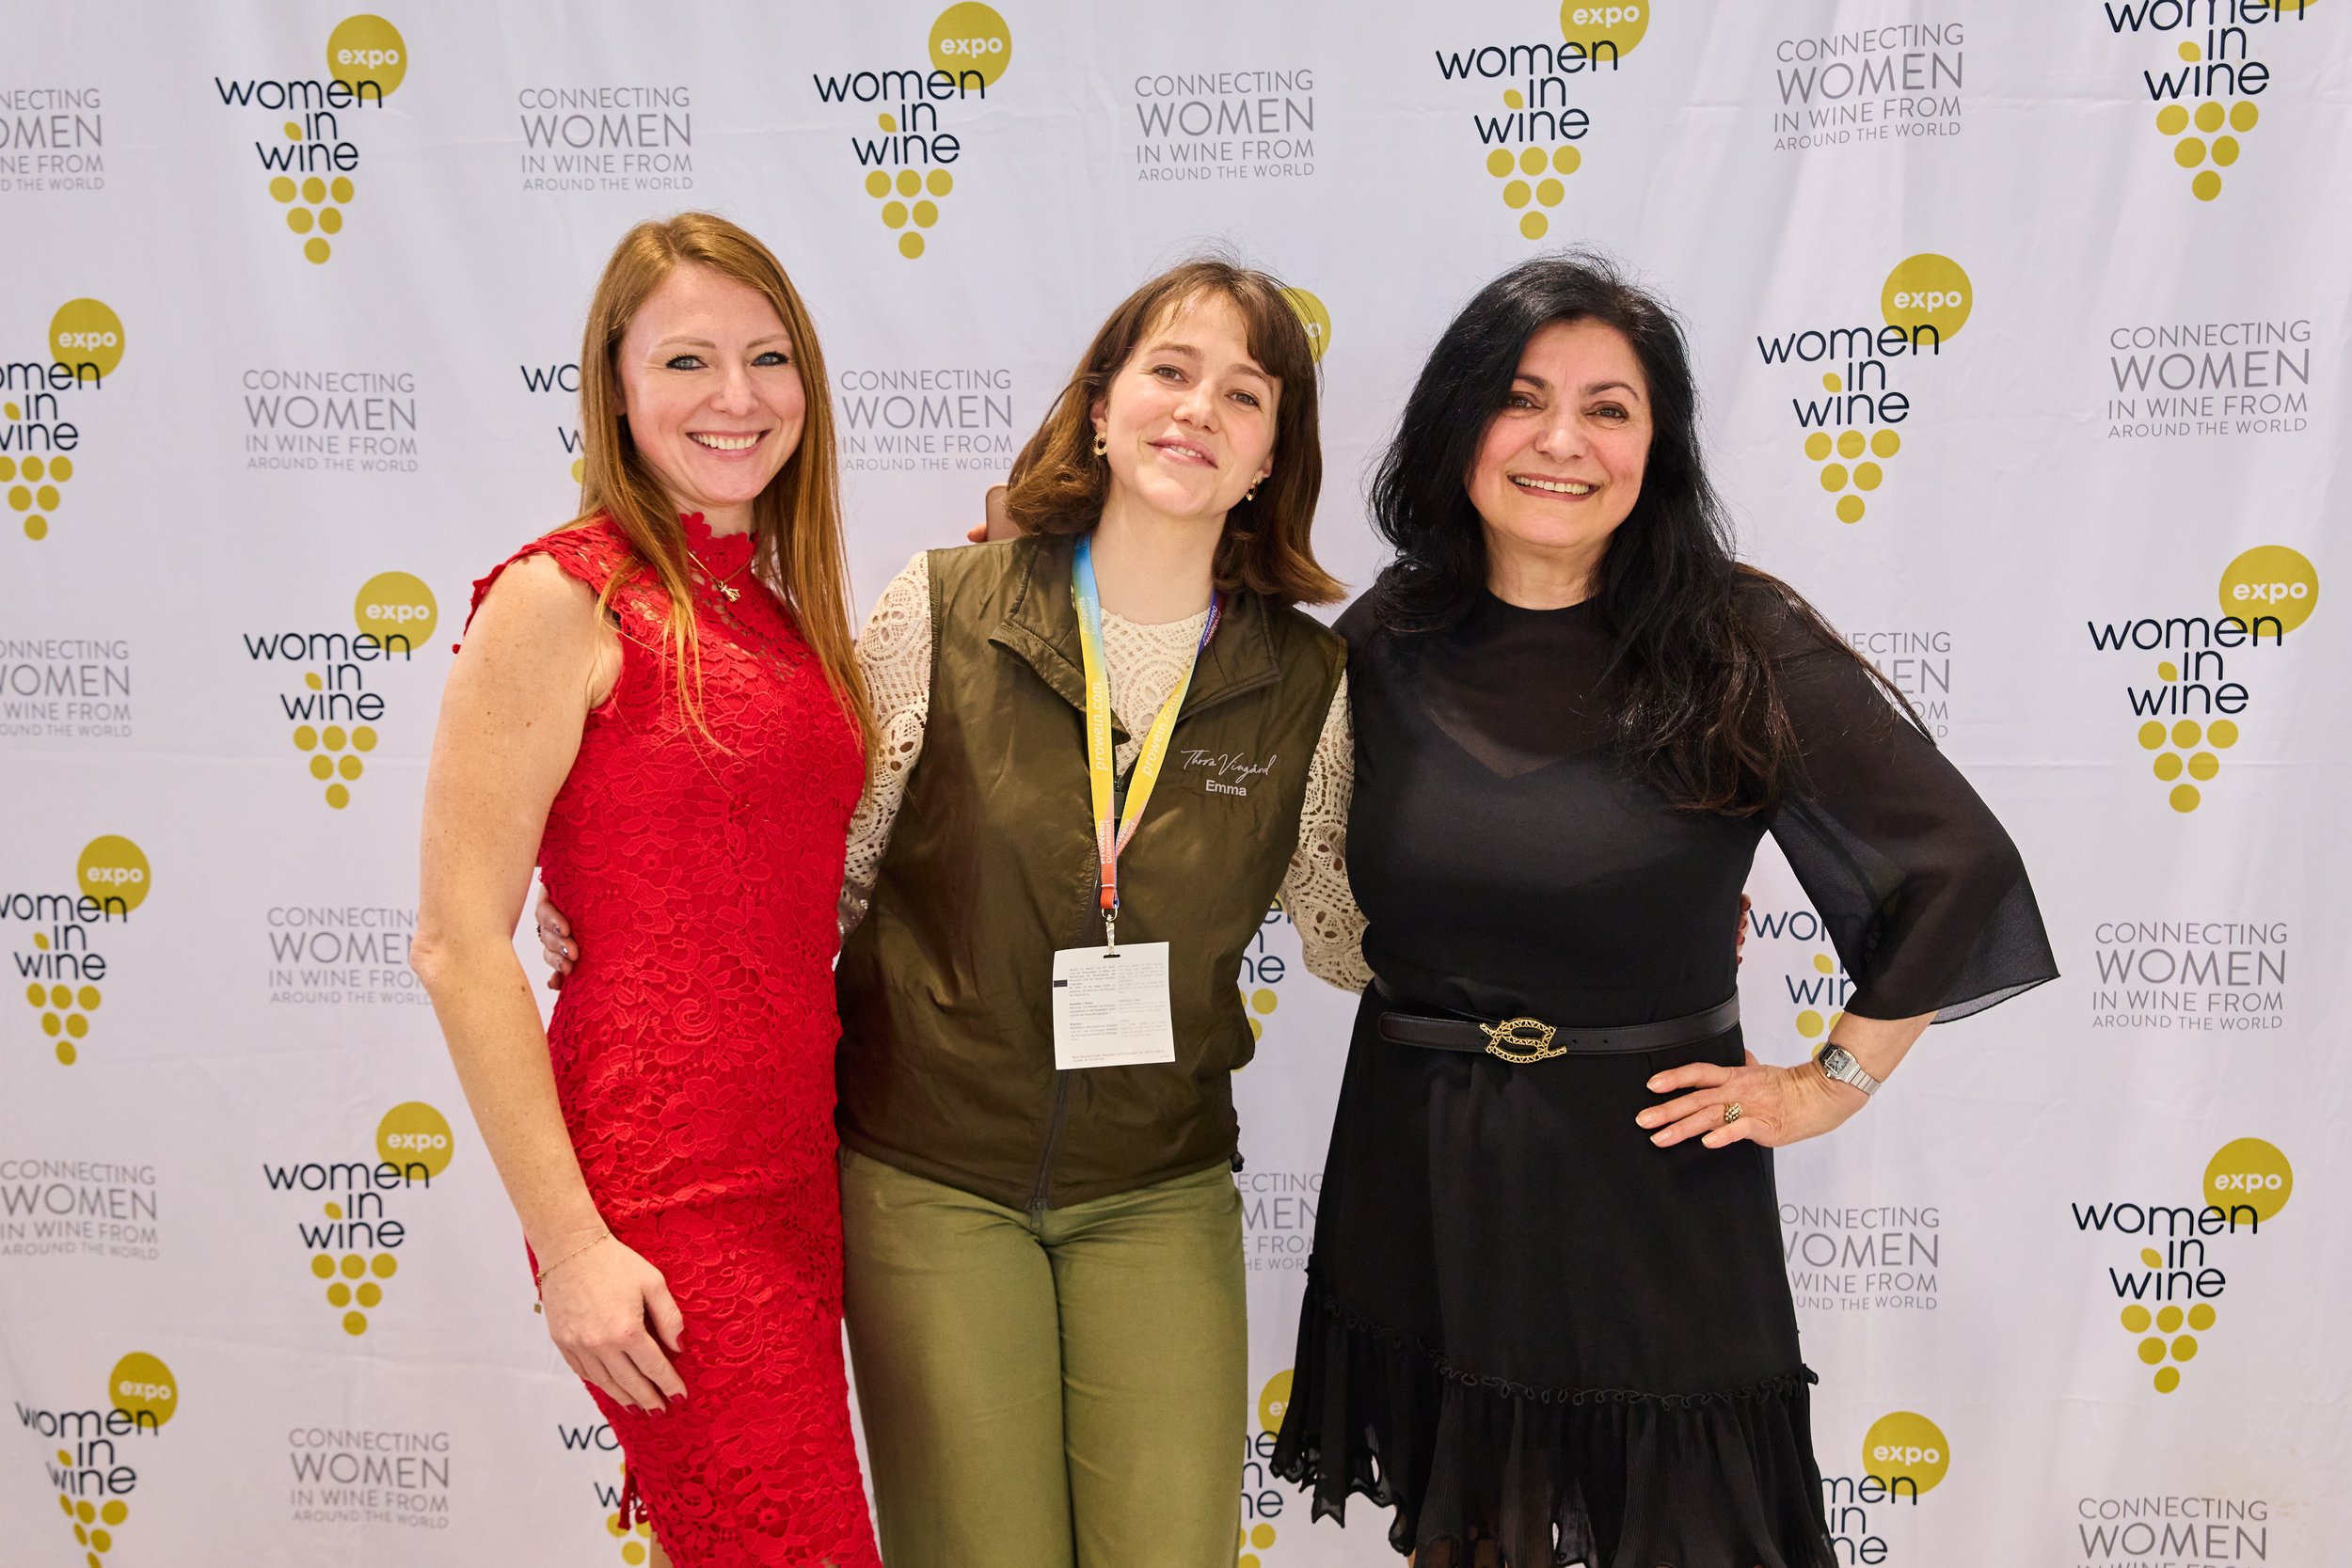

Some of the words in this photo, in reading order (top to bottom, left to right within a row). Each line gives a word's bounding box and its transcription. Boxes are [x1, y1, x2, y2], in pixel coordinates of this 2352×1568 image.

[1572, 5, 1640, 29] expo
[2104, 0, 2305, 34] women
[940, 36, 1003, 59] expo
[1776, 23, 1963, 63] CONNECTING
[2207, 26, 2247, 61] in
[336, 47, 400, 70] expo
[1435, 40, 1618, 80] women
[813, 70, 985, 103] women
[1135, 69, 1313, 97] CONNECTING
[1529, 76, 1566, 109] in
[1776, 52, 1963, 105] WOMEN
[2143, 61, 2270, 102] wine
[0, 88, 101, 110] NECTING
[215, 76, 383, 110] women
[518, 87, 690, 109] CONNECTING
[306, 111, 338, 141] in
[901, 102, 937, 133] in
[1136, 96, 1313, 138] WOMEN
[1473, 108, 1590, 145] wine
[1774, 111, 1799, 133] IN
[1808, 102, 1873, 129] WINE
[1883, 96, 1961, 119] FROM
[520, 113, 691, 149] WOMEN
[1774, 130, 1851, 150] AROUND
[1856, 125, 1888, 141] THE
[1895, 122, 1961, 136] WORLD
[38, 154, 104, 173] FROM
[255, 141, 359, 172] wine
[522, 155, 545, 173] IN
[553, 154, 615, 173] WINE
[624, 153, 692, 172] FROM
[851, 133, 961, 166] wine
[1137, 145, 1161, 164] IN
[1169, 141, 1232, 163] WINE
[1243, 138, 1314, 160] FROM
[16, 178, 44, 191] THE
[49, 177, 104, 190] WORLD
[524, 179, 595, 191] AROUND
[600, 178, 629, 190] THE
[635, 177, 692, 190] WORLD
[1138, 166, 1211, 181] AROUND
[1216, 166, 1248, 179] THE
[1254, 163, 1314, 177] WORLD
[1893, 290, 1963, 313] expo
[58, 331, 118, 352] expo
[1756, 324, 1940, 365] women
[2110, 320, 2311, 350] CONNECTING
[0, 361, 102, 391] men
[243, 370, 414, 393] CONNECTING
[840, 369, 1011, 391] CONNECTING
[1848, 359, 1886, 392] in
[2110, 348, 2310, 393] WOMEN
[25, 392, 58, 420] in
[244, 395, 416, 431] WOMEN
[841, 395, 1012, 429] WOMEN
[1792, 391, 1910, 428] wine
[2108, 399, 2135, 420] IN
[2146, 396, 2214, 419] WINE
[2224, 392, 2307, 416] FROM
[2108, 422, 2190, 438] AROUND
[2196, 421, 2229, 436] THE
[2236, 418, 2307, 434] WORLD
[246, 435, 267, 451] IN
[276, 435, 339, 454] WINE
[349, 436, 417, 455] FROM
[844, 436, 866, 454] IN
[874, 436, 935, 453] WINE
[944, 435, 1012, 453] FROM
[248, 457, 317, 469] AROUND
[325, 458, 353, 470] THE
[361, 460, 418, 471] WORLD
[845, 458, 915, 470] AROUND
[921, 458, 949, 470] THE
[956, 458, 1013, 470] WORLD
[2233, 581, 2309, 605] expo
[365, 603, 430, 625] expo
[243, 632, 411, 662] women
[2087, 615, 2283, 651] women
[0, 639, 130, 659] NNECTING
[0, 664, 130, 696] OMEN
[327, 663, 362, 690] in
[2183, 650, 2224, 682] in
[3, 702, 59, 721] WINE
[67, 702, 132, 721] FROM
[280, 692, 385, 721] wine
[2126, 682, 2249, 717] wine
[46, 724, 74, 736] THE
[77, 724, 133, 737] WORLD
[1091, 681, 1108, 771] prowein.com
[1142, 693, 1180, 779] prowein.com
[1205, 779, 1248, 797] Emma
[87, 867, 143, 886] expo
[267, 907, 420, 927] CONNECTIN
[54, 924, 87, 951] in
[2095, 922, 2287, 945] CONNECTING
[13, 952, 106, 981] wine
[269, 970, 293, 987] IN
[300, 969, 361, 988] WINE
[2095, 948, 2285, 987] WOMEN
[270, 991, 342, 1004] AROUND
[347, 991, 377, 1004] THE
[2093, 990, 2117, 1010] IN
[2126, 990, 2197, 1012] WINE
[2208, 991, 2283, 1013] FROM
[2092, 1014, 2171, 1028] AROUND
[2178, 1016, 2213, 1030] THE
[2219, 1016, 2282, 1030] WORLD
[387, 1133, 447, 1152] expo
[0, 1159, 156, 1185] CONNECTING
[263, 1162, 430, 1191] women
[2214, 1173, 2282, 1194] expo
[1, 1183, 157, 1221] WOMEN
[348, 1192, 383, 1219] in
[1779, 1203, 1939, 1228] ONNECTING
[0, 1223, 24, 1240] IN
[34, 1220, 93, 1239] WINE
[98, 1224, 158, 1243] FROM
[2071, 1202, 2259, 1237] women
[299, 1220, 405, 1249] wine
[2168, 1238, 2204, 1270] in
[1791, 1271, 1856, 1293] WINE
[1867, 1273, 1937, 1292] FROM
[2108, 1267, 2226, 1301] wine
[1840, 1297, 1869, 1310] THE
[1875, 1295, 1937, 1309] WORLD
[119, 1382, 170, 1400] expo
[15, 1401, 158, 1438] women
[78, 1439, 115, 1467] in
[289, 1428, 450, 1452] CONNECTING
[1873, 1445, 1940, 1466] expo
[45, 1461, 136, 1496] wine
[290, 1452, 449, 1488] WOMEN
[291, 1490, 313, 1505] IN
[321, 1489, 378, 1507] WINE
[385, 1491, 449, 1513] FROM
[1821, 1475, 1917, 1506] men
[1830, 1506, 1867, 1535] in
[2078, 1497, 2267, 1521] CONNECTING
[1831, 1536, 1887, 1565] ne
[2079, 1522, 2266, 1561] WOMEN
